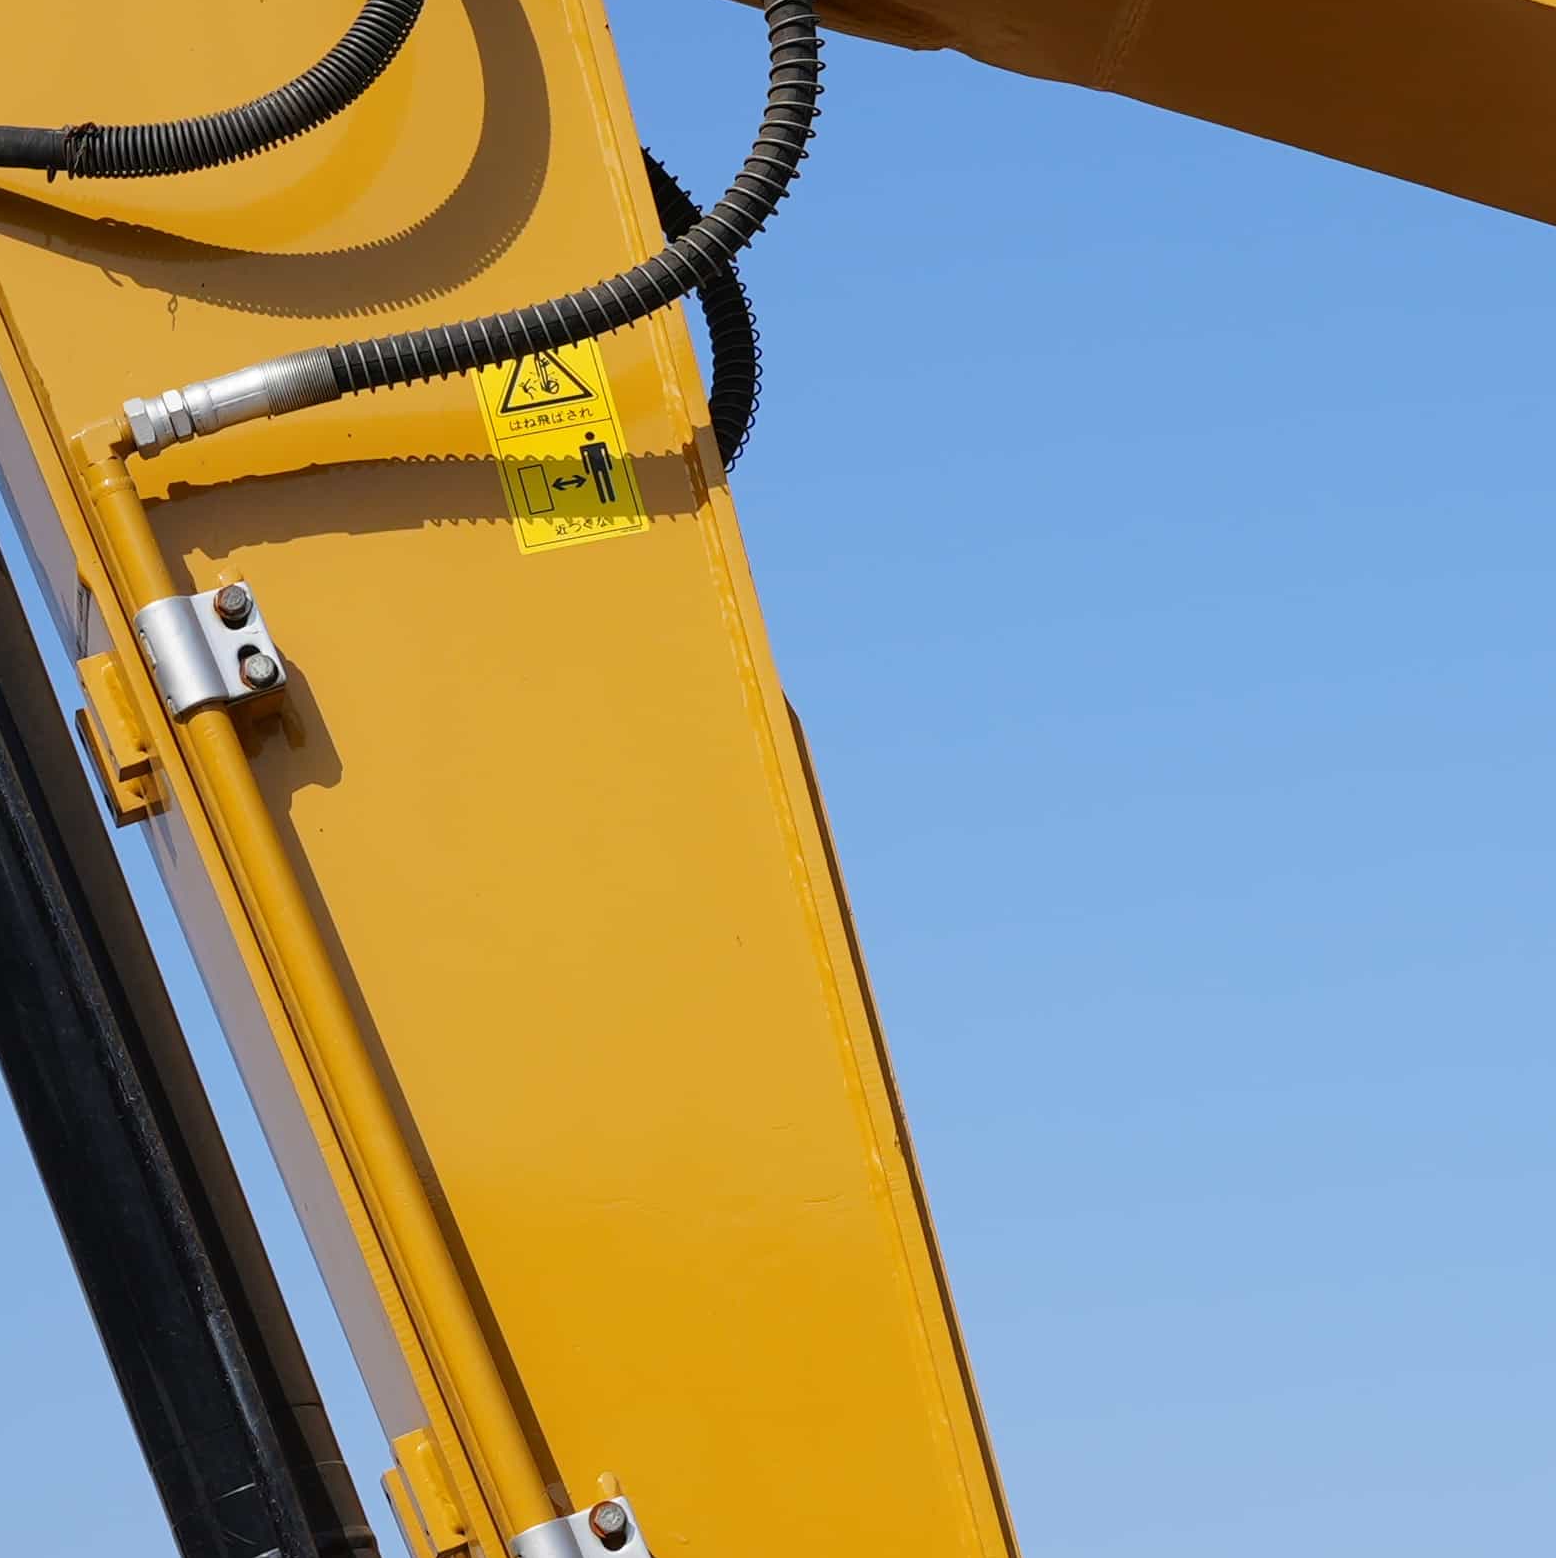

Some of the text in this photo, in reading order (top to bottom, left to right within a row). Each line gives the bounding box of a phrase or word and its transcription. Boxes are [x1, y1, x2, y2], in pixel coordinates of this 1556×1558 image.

[508, 406, 594, 432] はね飛ばされ
